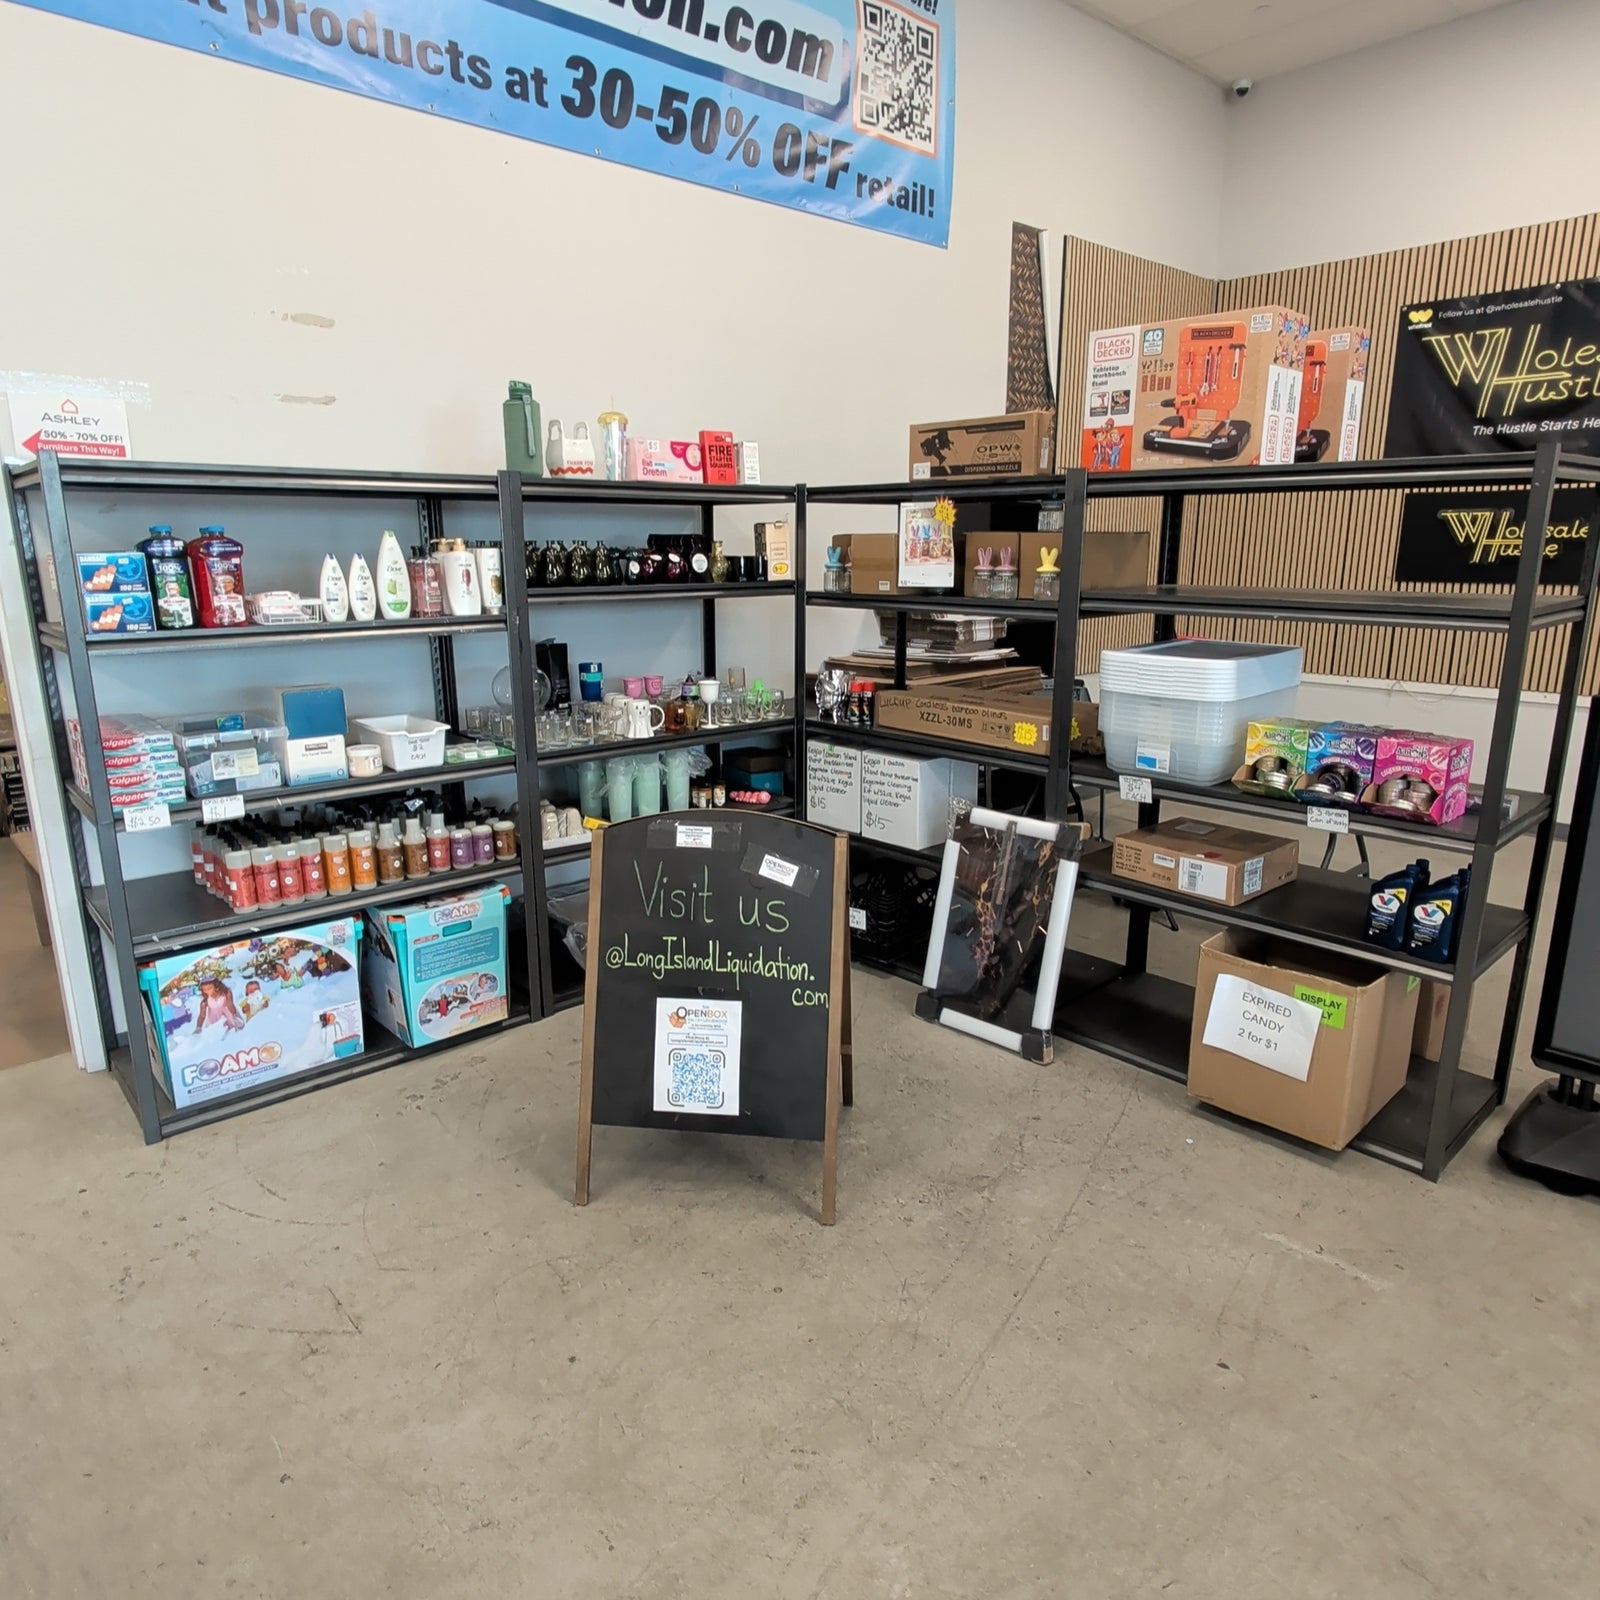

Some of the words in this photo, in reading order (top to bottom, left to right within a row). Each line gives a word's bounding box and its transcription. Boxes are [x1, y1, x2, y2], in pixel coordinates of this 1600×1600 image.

[244, 0, 493, 91] products
[505, 65, 549, 109] at
[560, 54, 761, 169] 30-50%
[772, 122, 855, 191] OFF
[856, 172, 935, 218] retail!
[1438, 308, 1463, 319] Follow
[1464, 307, 1475, 317] us
[1475, 306, 1485, 315] at
[1486, 295, 1563, 315] @wholesalehustle
[1145, 329, 1163, 342] 40
[1097, 346, 1131, 358] DECKER
[41, 411, 101, 426] ASHLEY
[1473, 424, 1494, 436] The
[1496, 421, 1537, 435] Hustle
[1540, 418, 1579, 432] Starts
[44, 430, 67, 440] 50%
[77, 432, 98, 443] 70%
[100, 434, 123, 444] OFF!
[37, 442, 78, 453] Furniture
[80, 445, 97, 454] This
[98, 446, 120, 456] Way!
[708, 444, 733, 457] FIRE
[977, 444, 1013, 454] OPW
[709, 456, 733, 464] STARTER
[919, 711, 973, 729] XZZL-30MS
[103, 738, 133, 748] olgate
[109, 775, 144, 785] Colgate
[111, 793, 145, 803] Colgate
[864, 809, 894, 830] $15
[634, 859, 714, 924] Visit
[739, 895, 790, 933] us
[605, 932, 815, 992] @LongIslandLiquidation.
[791, 987, 829, 1008] com
[1242, 991, 1292, 1018] EXPIRED
[1301, 992, 1342, 1010] DISPLAY
[676, 1006, 728, 1019] OPENBOX
[1321, 1011, 1333, 1021] LY
[1242, 1010, 1285, 1034] CANDY
[1238, 1027, 1245, 1038] 2
[1247, 1031, 1263, 1046] for
[1264, 1038, 1278, 1051] $1
[182, 1041, 282, 1087] FOAMO
